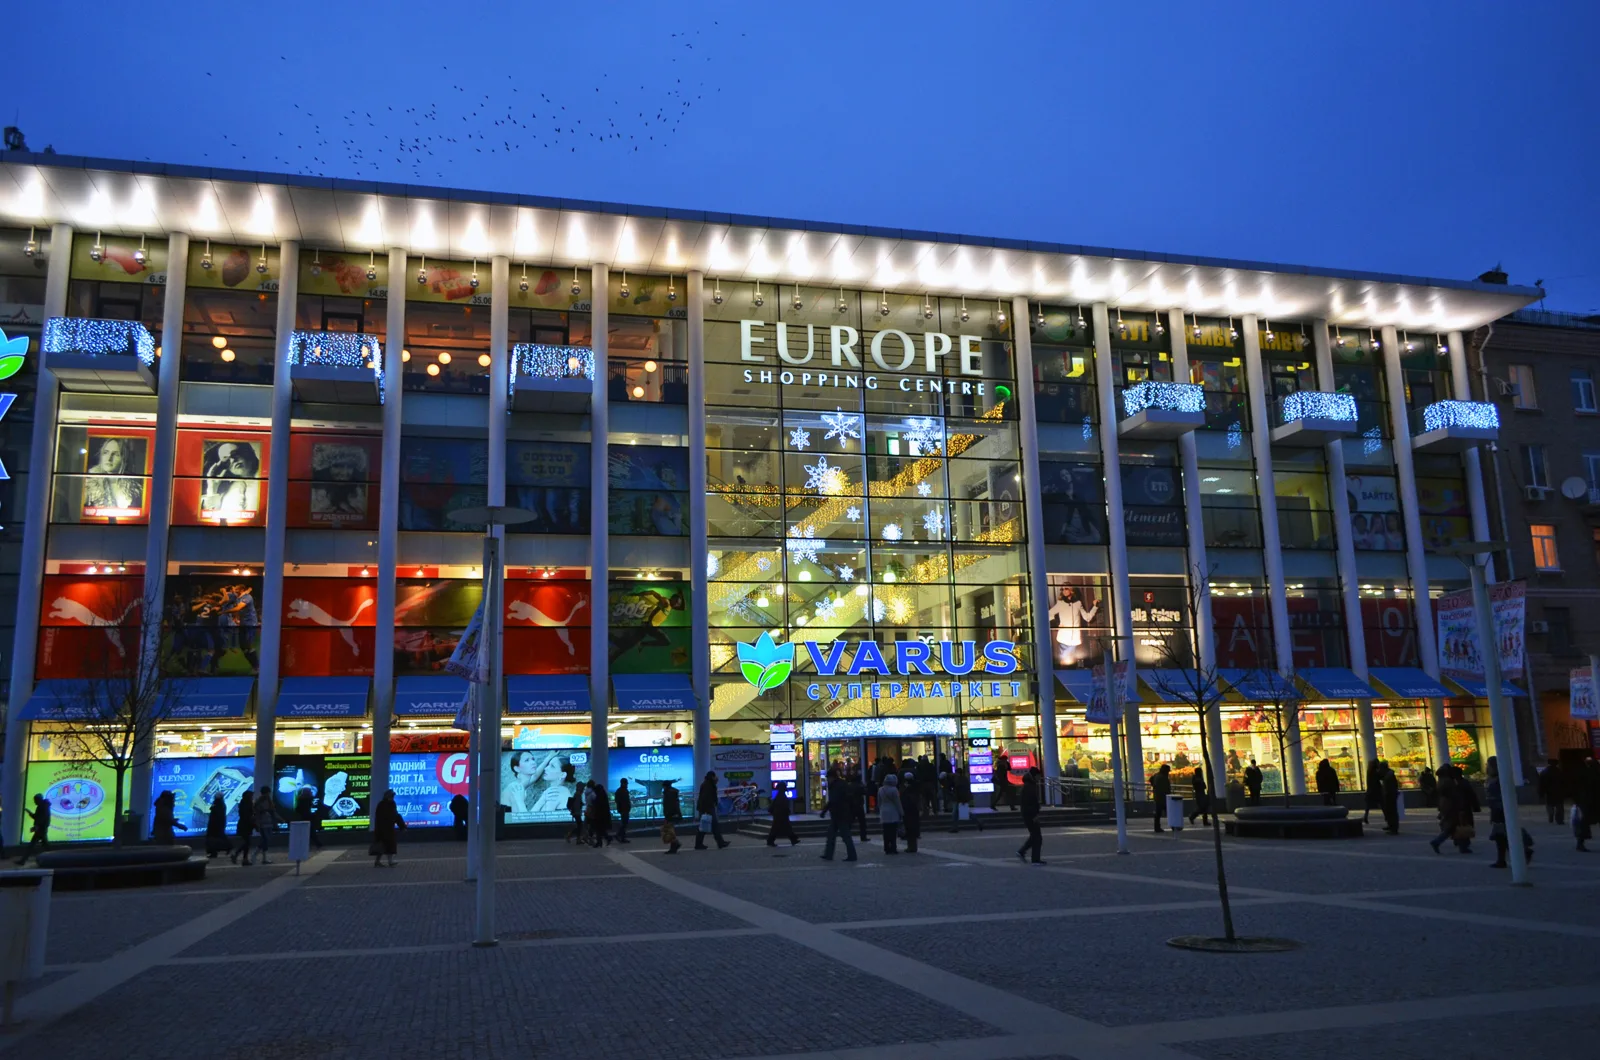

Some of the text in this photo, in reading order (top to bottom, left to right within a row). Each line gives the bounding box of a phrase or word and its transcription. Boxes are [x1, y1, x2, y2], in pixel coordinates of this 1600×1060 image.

[573, 303, 591, 311] 6.00
[740, 319, 983, 375] EUROPE
[743, 369, 985, 396] SHOPPING CENTRE
[804, 640, 1018, 675] VARUS
[807, 680, 1021, 701] СУПЕРМАРКЕТ
[571, 754, 585, 763] 925
[639, 753, 670, 763] Gross
[389, 759, 426, 772] МОДНИЙ
[442, 752, 470, 784] G
[158, 774, 195, 783] KLEYNOD
[413, 773, 425, 783] ТА
